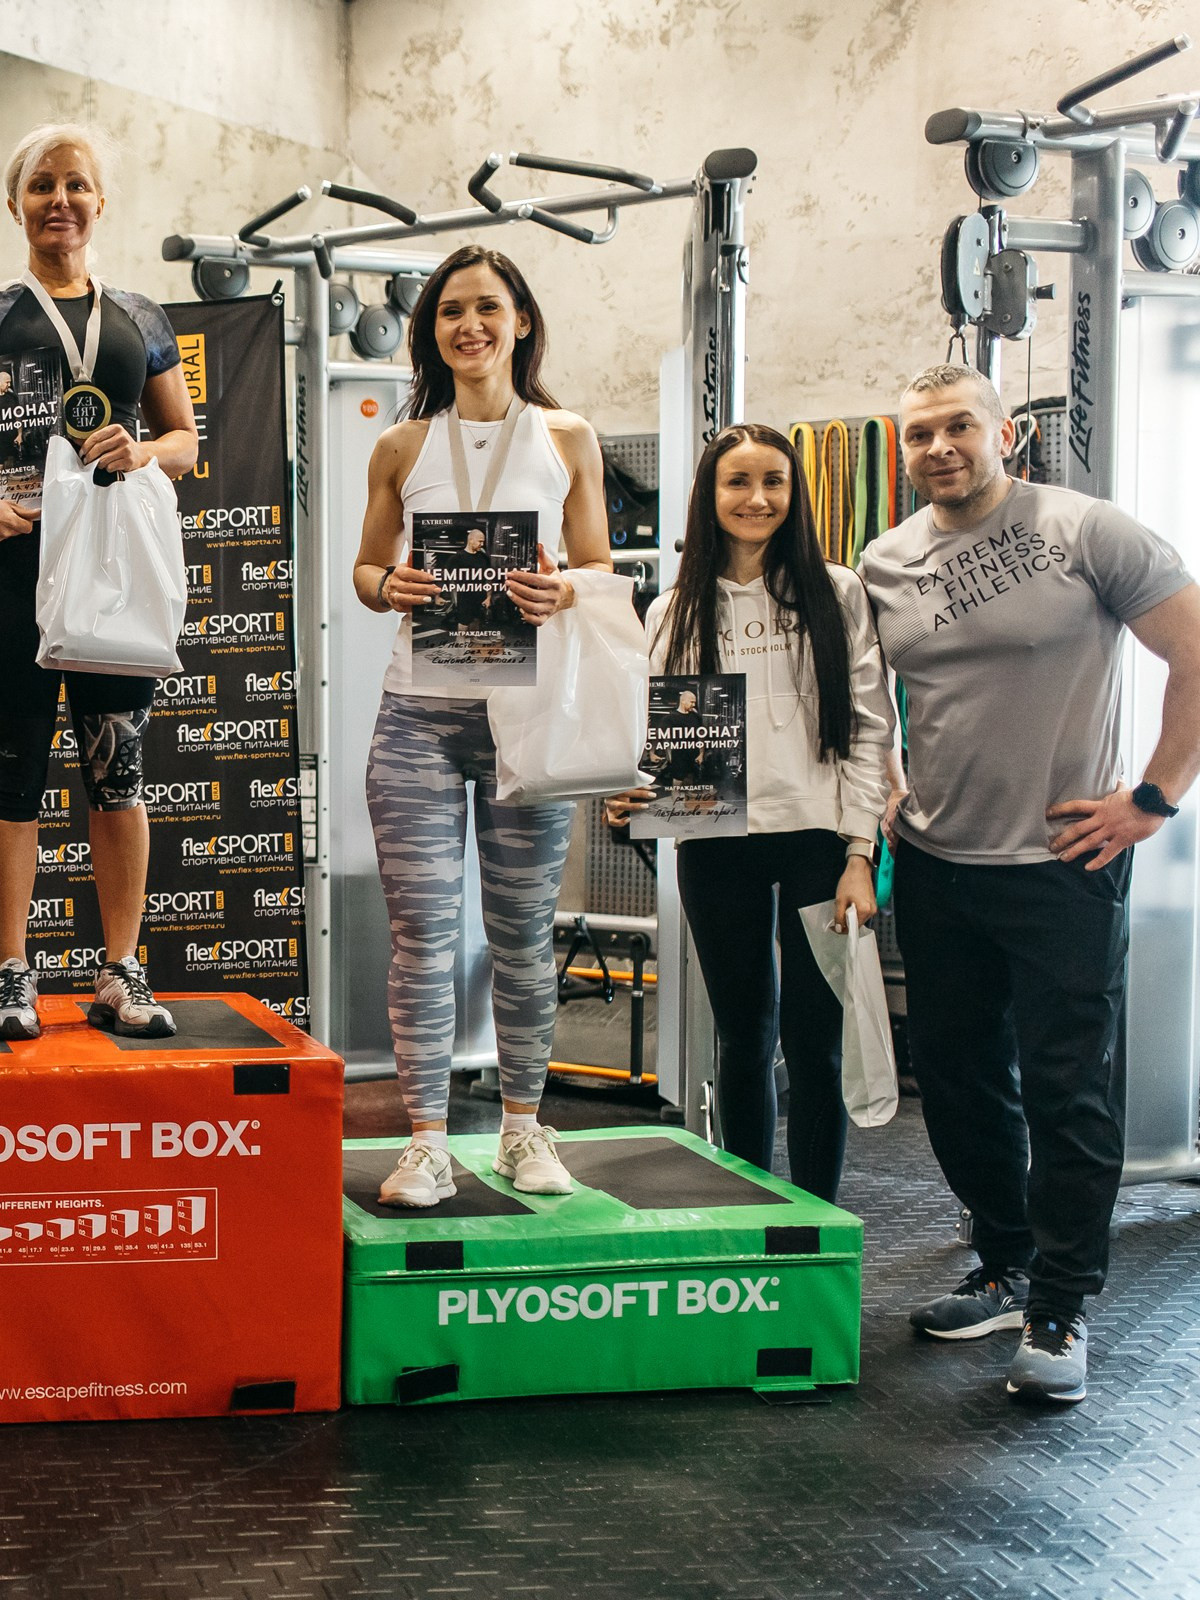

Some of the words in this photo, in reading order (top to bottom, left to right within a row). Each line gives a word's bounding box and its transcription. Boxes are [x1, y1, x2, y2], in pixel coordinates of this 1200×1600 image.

[182, 339, 201, 398] URAL
[916, 522, 1029, 596] EXTREME
[944, 533, 1046, 600] FITNESS
[442, 583, 511, 592] АРМЛИФТИ
[934, 544, 1066, 632] ATHLETICS
[241, 633, 284, 642] ПИТАНИЕ
[648, 725, 740, 740] ЕМПИОНАТ
[177, 742, 242, 752] СПОРТИВНОЕ
[244, 740, 289, 749] ПИТАНИЕ
[656, 740, 739, 750] АРМЛИФТИНГУ
[181, 856, 247, 866] СПОРТИВНОЕ
[248, 854, 294, 863] ПИТАНИЕ
[185, 961, 251, 971] СПОРТИВНОЕ
[252, 959, 298, 968] ПИТАНИЕ
[56, 1199, 104, 1209] HEIGHTS.
[438, 1281, 668, 1326] PLYOSOFT
